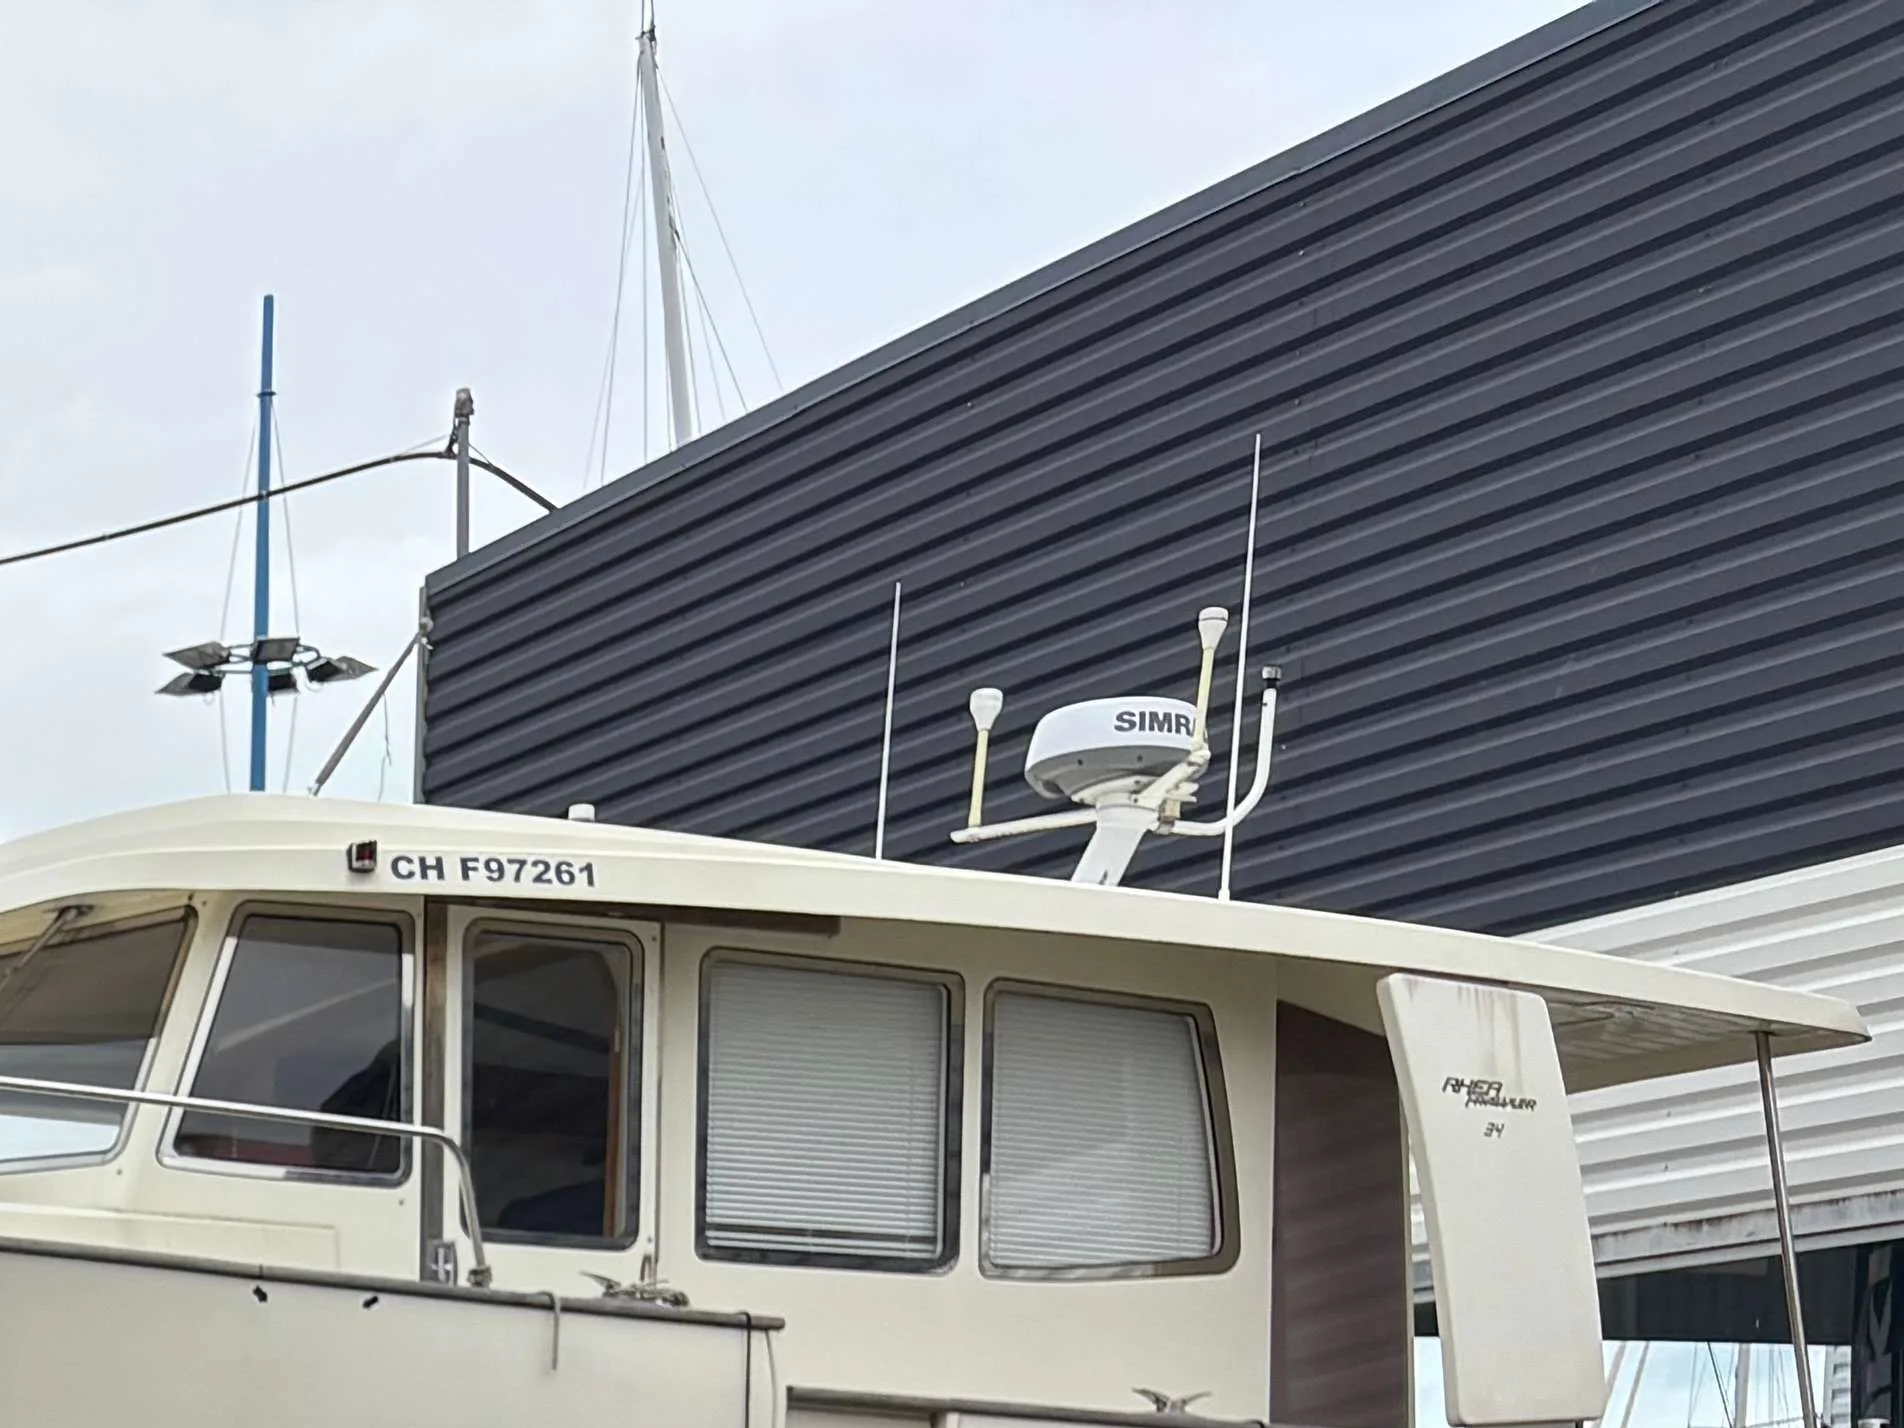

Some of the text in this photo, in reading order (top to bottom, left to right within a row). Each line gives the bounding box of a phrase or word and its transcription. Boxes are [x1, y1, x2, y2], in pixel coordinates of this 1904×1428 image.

[1114, 710, 1196, 736] SIMR
[391, 855, 596, 888] CH F97261
